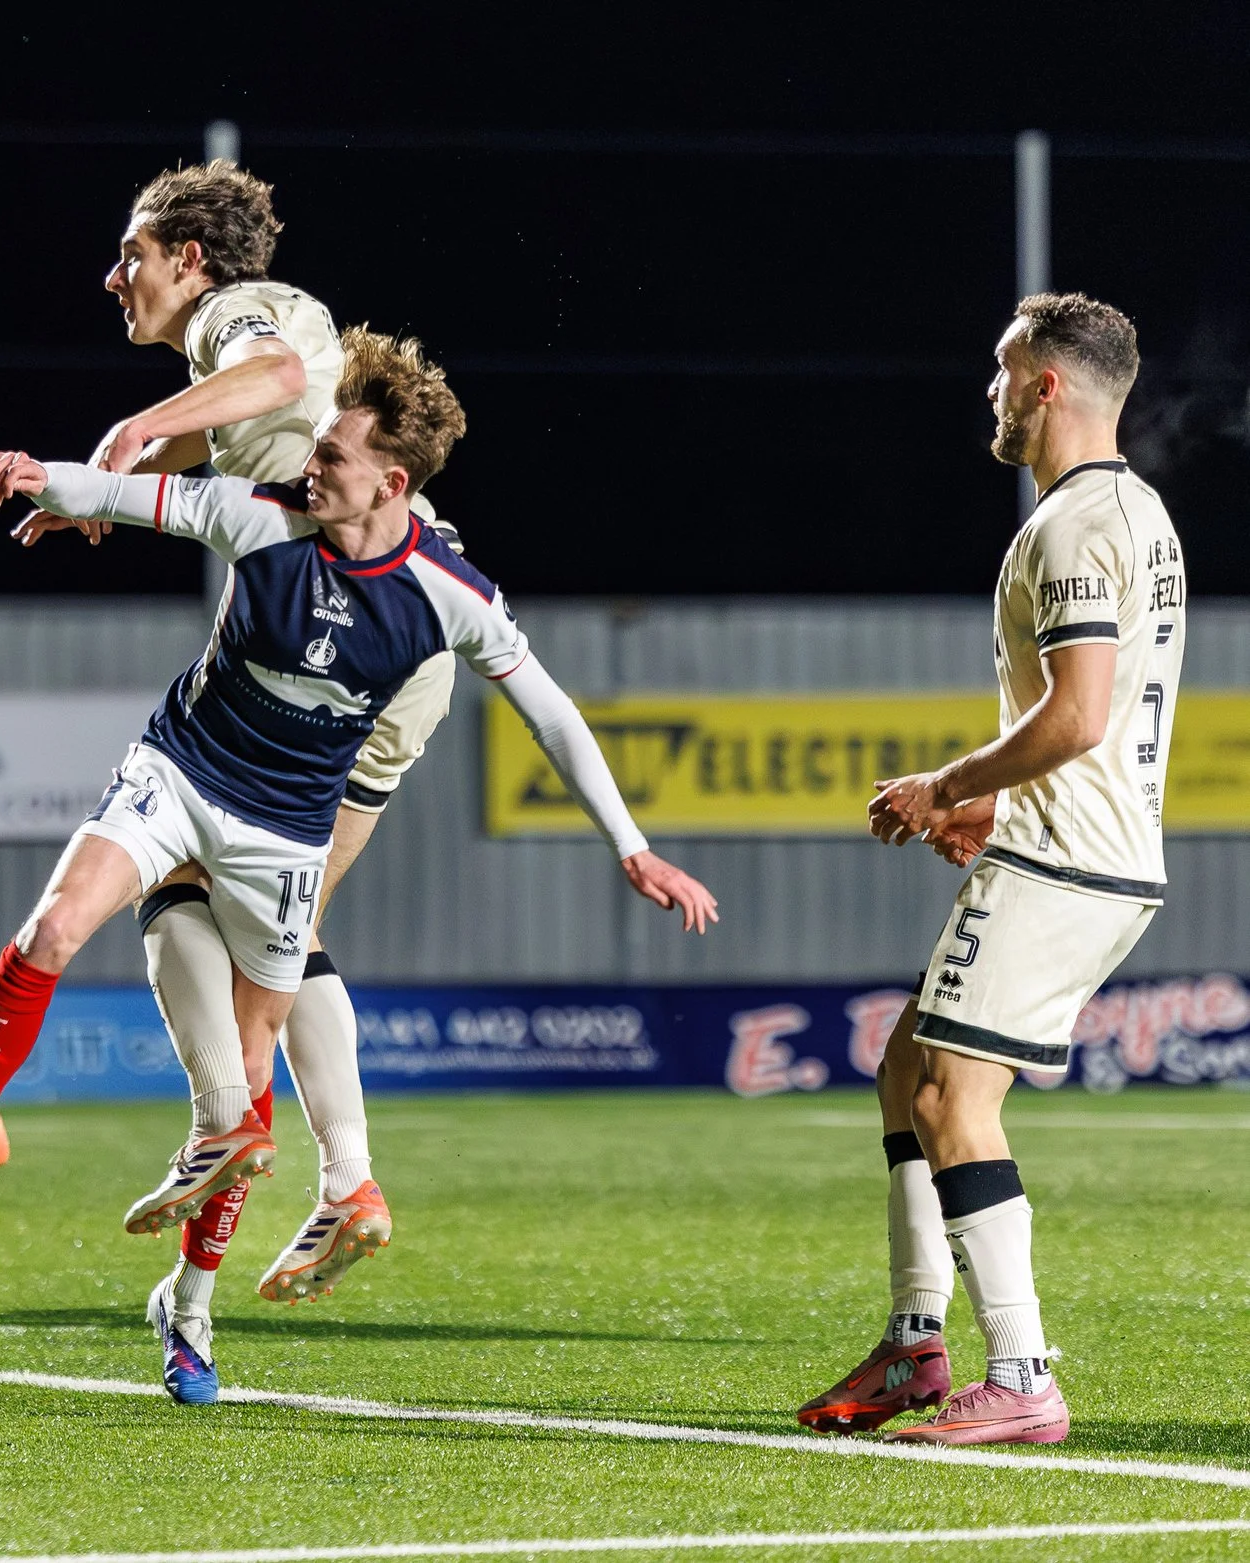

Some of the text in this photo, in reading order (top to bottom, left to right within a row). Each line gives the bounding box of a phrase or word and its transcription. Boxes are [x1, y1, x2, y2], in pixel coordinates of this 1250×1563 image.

[1039, 576, 1110, 608] FAVELA
[695, 726, 998, 795] ELECTRIC
[277, 870, 319, 925] 14
[944, 906, 990, 968] 5
